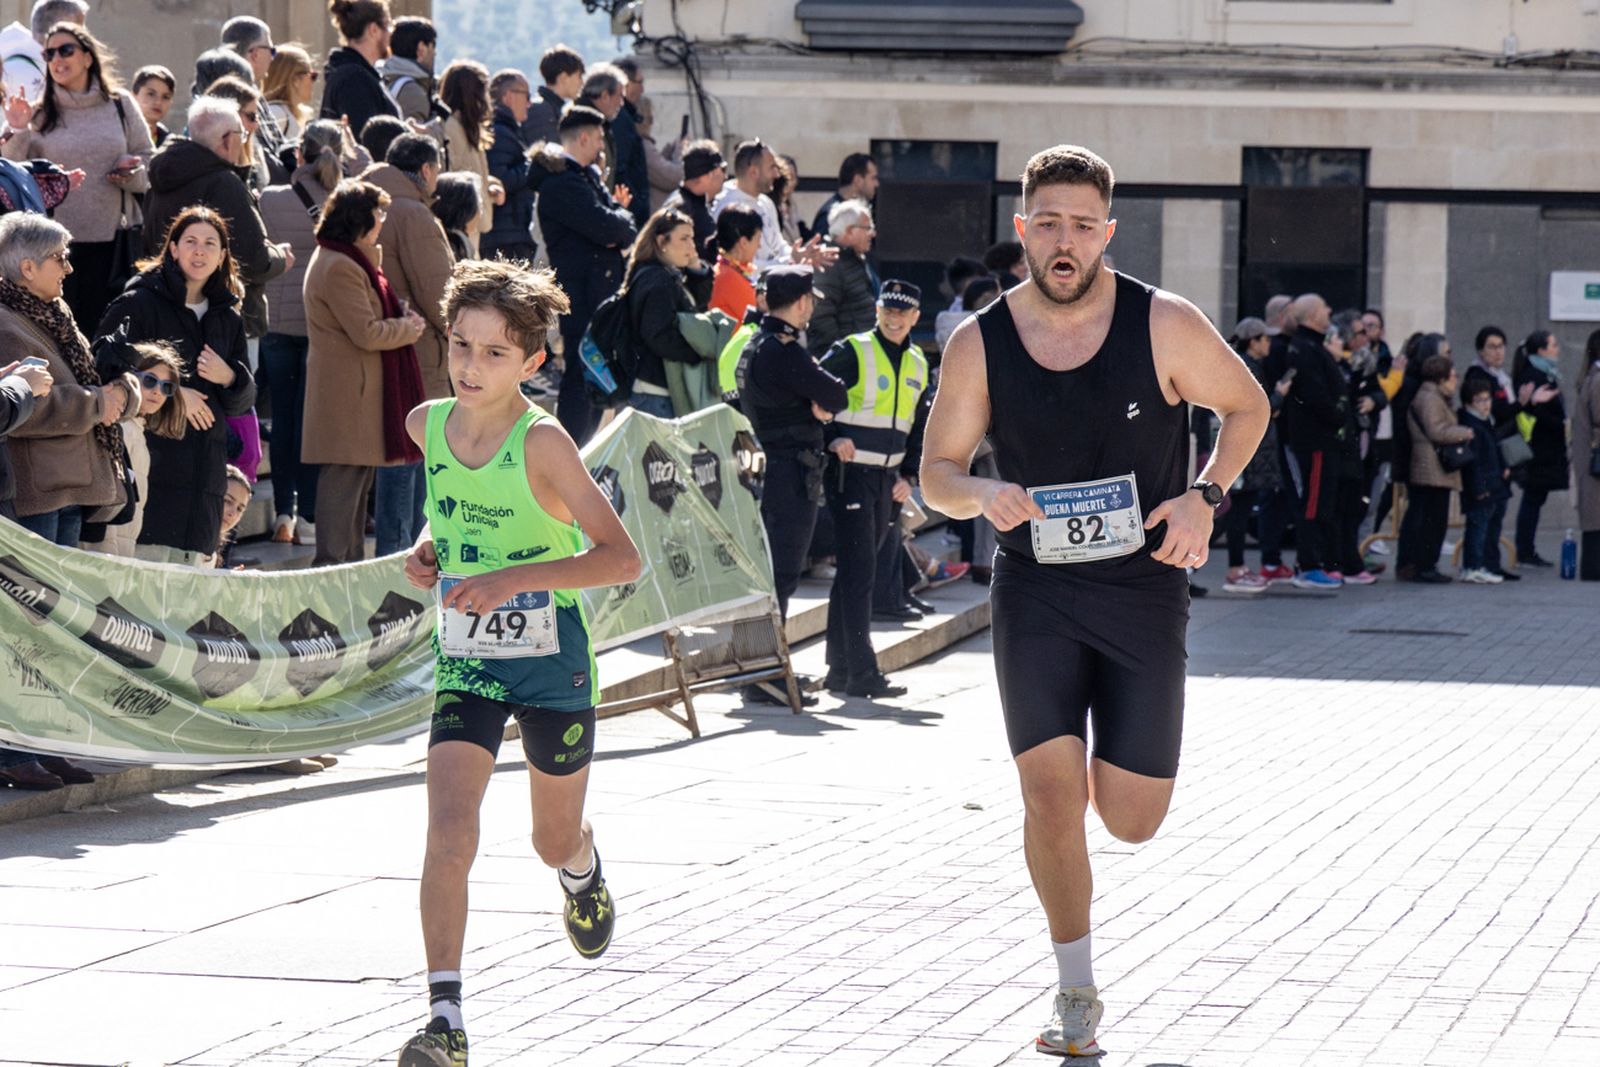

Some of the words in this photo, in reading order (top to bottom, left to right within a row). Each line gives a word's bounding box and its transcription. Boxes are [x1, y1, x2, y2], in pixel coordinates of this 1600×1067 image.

[1051, 491, 1082, 500] CARRERA
[1084, 485, 1121, 497] CAMINATA
[461, 500, 514, 517] Fundación
[1044, 502, 1071, 516] BUENA
[1072, 498, 1107, 513] MUERTE
[1067, 515, 1106, 545] 82
[466, 611, 527, 640] 749
